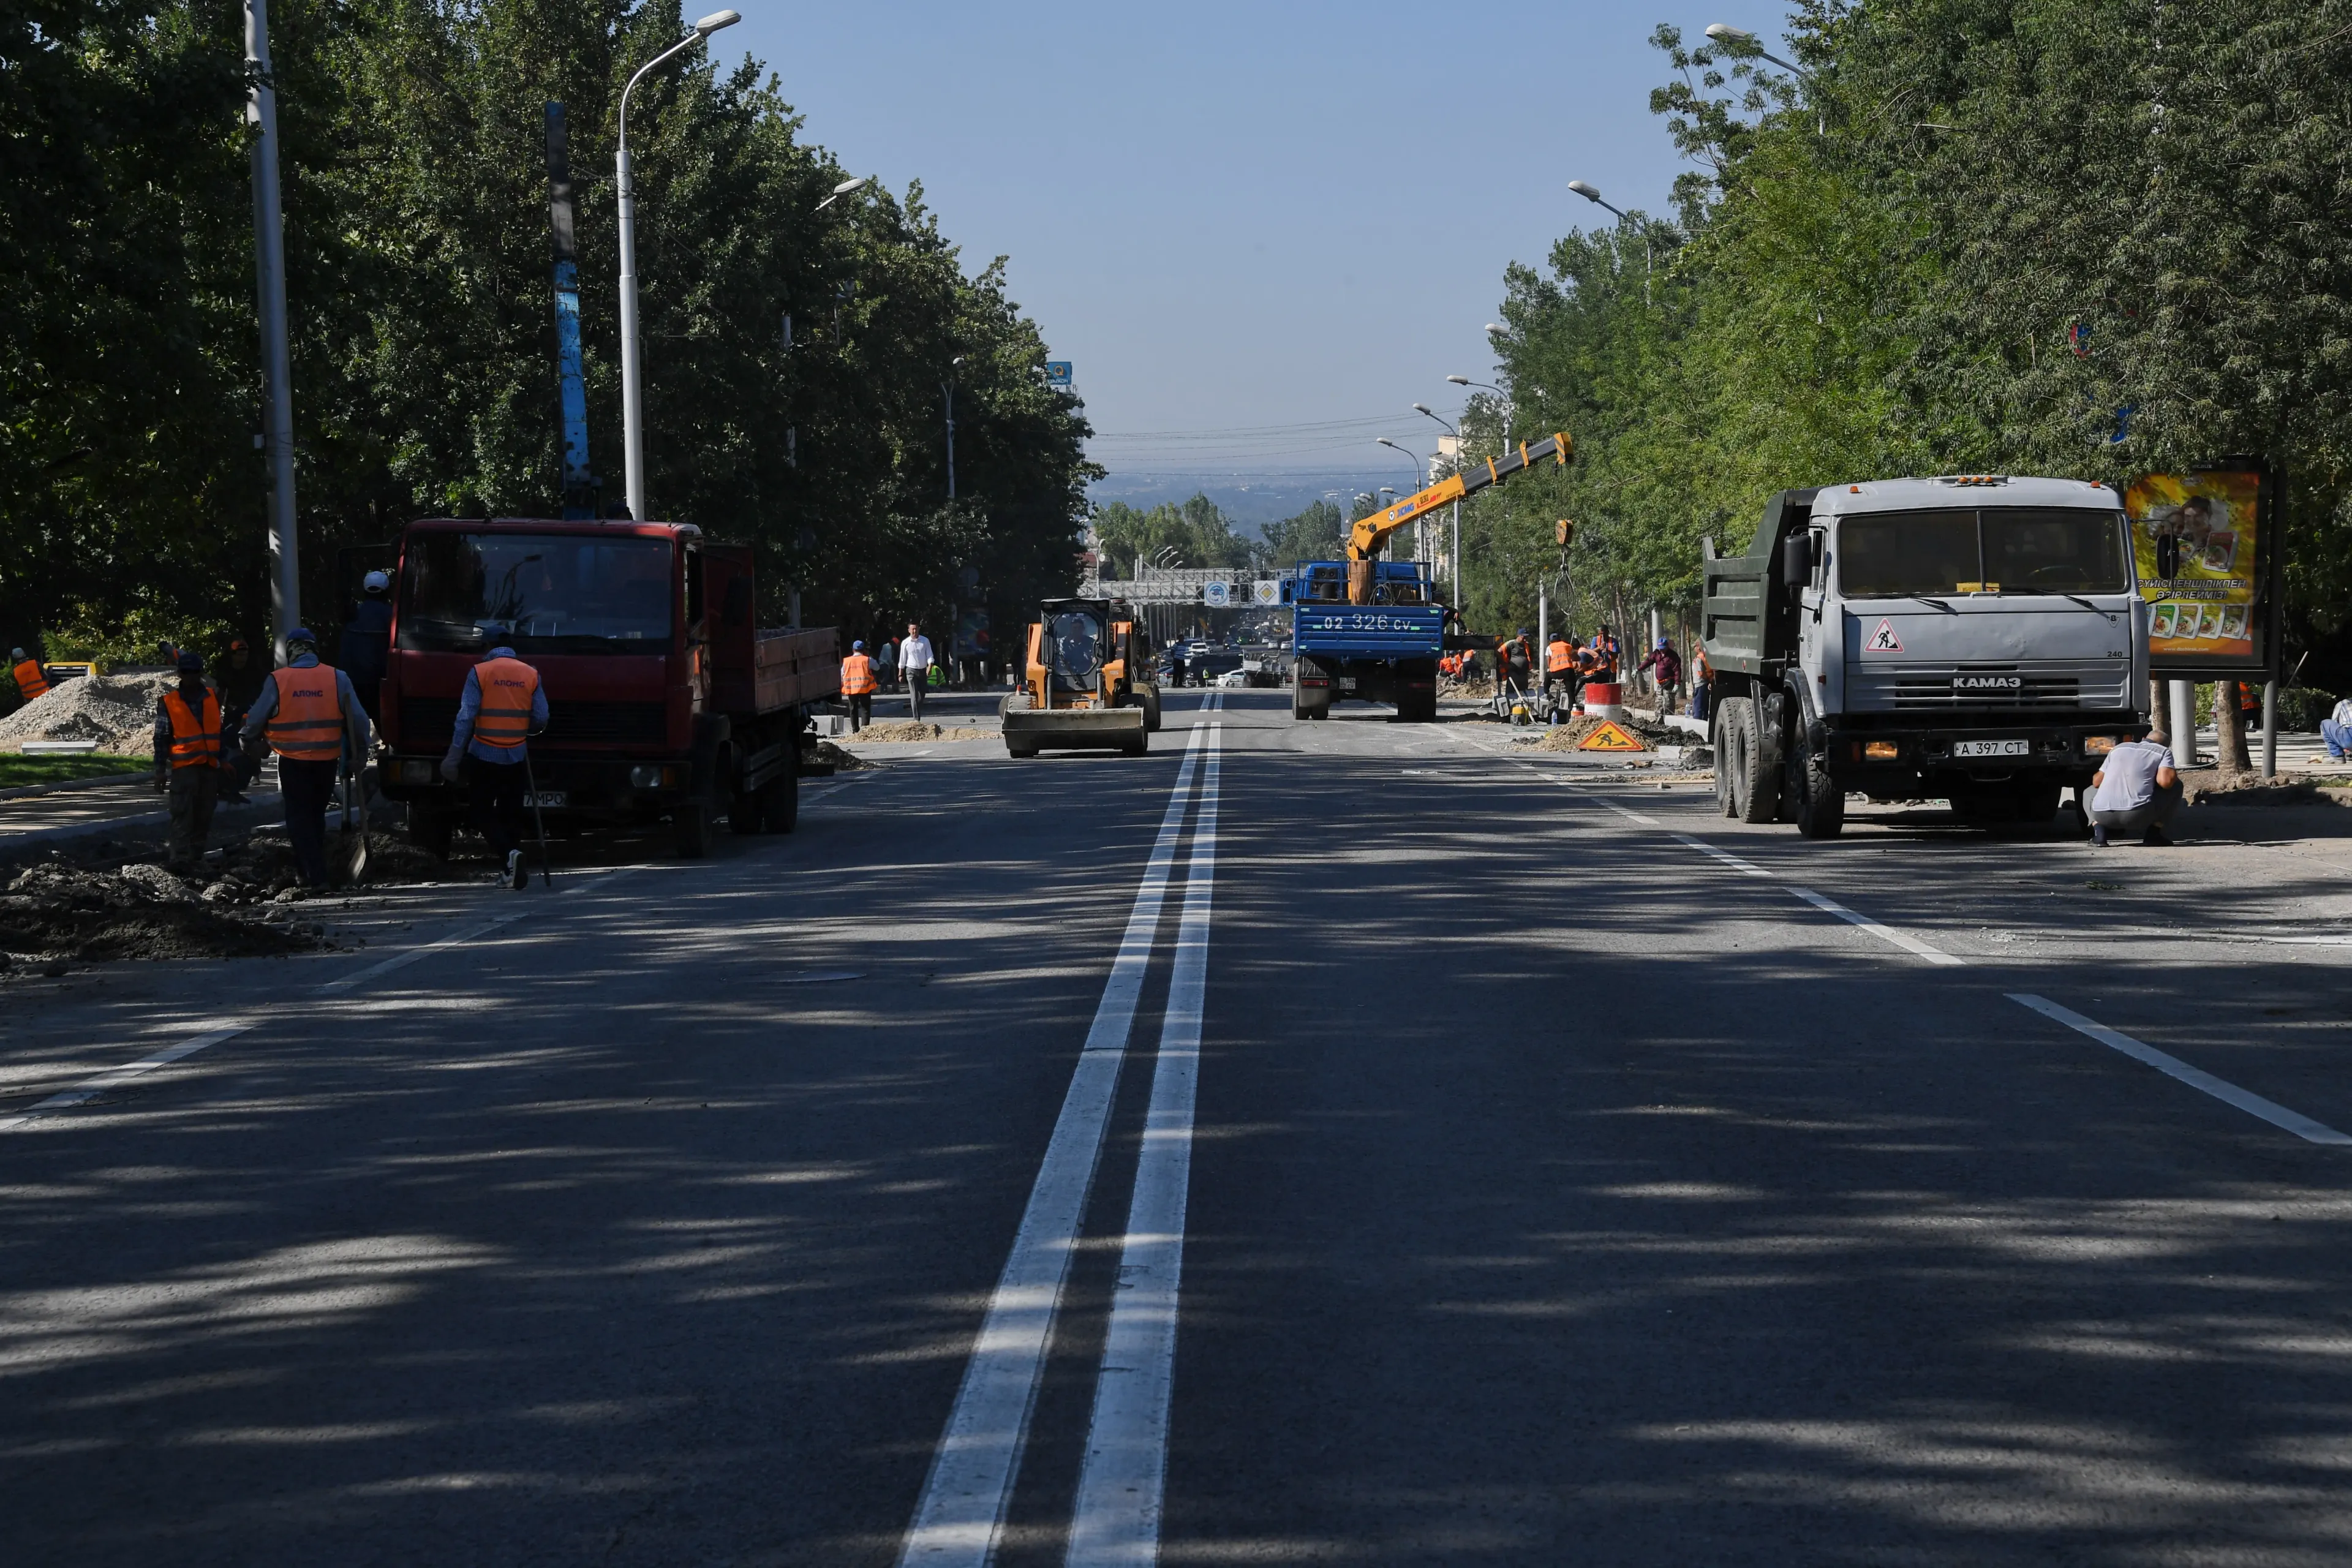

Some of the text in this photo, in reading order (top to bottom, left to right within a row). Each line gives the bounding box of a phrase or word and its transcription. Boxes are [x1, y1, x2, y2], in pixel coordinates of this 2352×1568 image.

[1397, 502, 1414, 518] XCMG
[1324, 617, 1343, 630] 02
[1352, 613, 1388, 630] 326
[1953, 677, 2021, 688] КАМАЗ
[1961, 742, 2022, 755] A 397 CT
